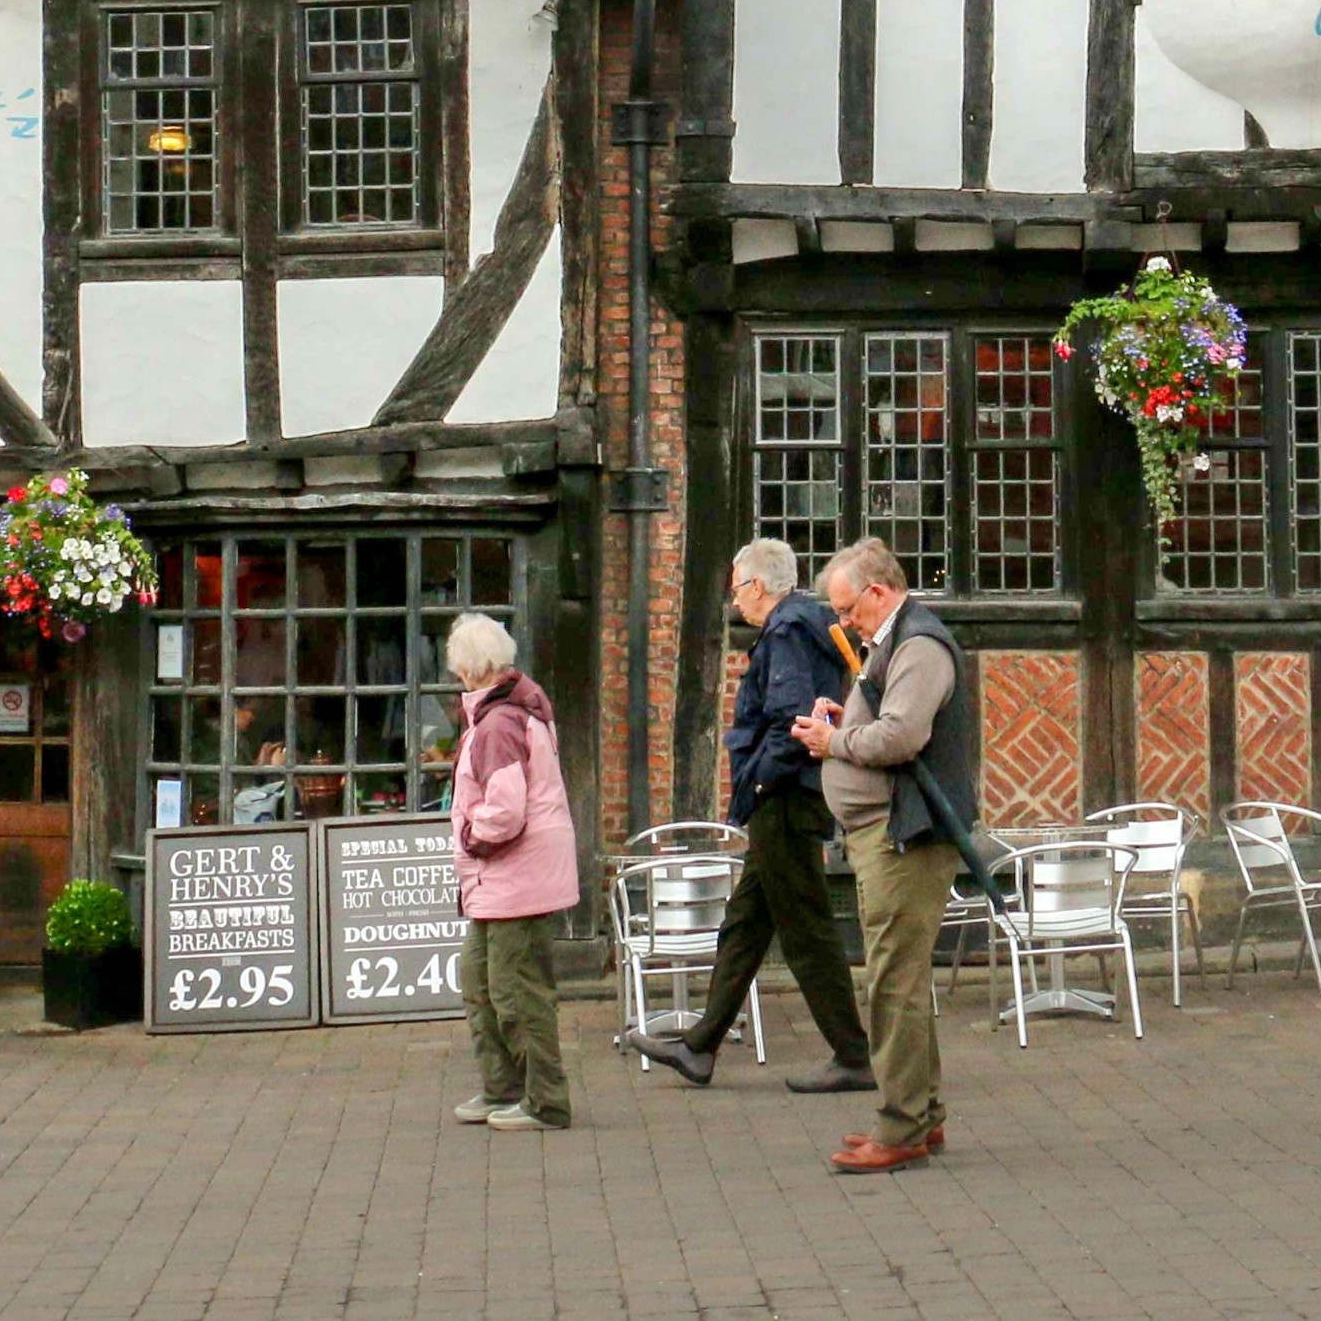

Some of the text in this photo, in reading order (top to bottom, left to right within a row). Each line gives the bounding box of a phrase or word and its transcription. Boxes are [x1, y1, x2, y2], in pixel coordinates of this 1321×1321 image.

[169, 844, 296, 877] GERT &
[341, 838, 408, 857] SPECIAL
[170, 873, 294, 902] HENRY'S
[342, 864, 460, 890] TEA COFFE
[342, 891, 373, 909] HOT
[169, 904, 295, 931] BEAUTIFUL
[168, 929, 295, 953] BREAKFASTS
[169, 965, 295, 1011] £2.95
